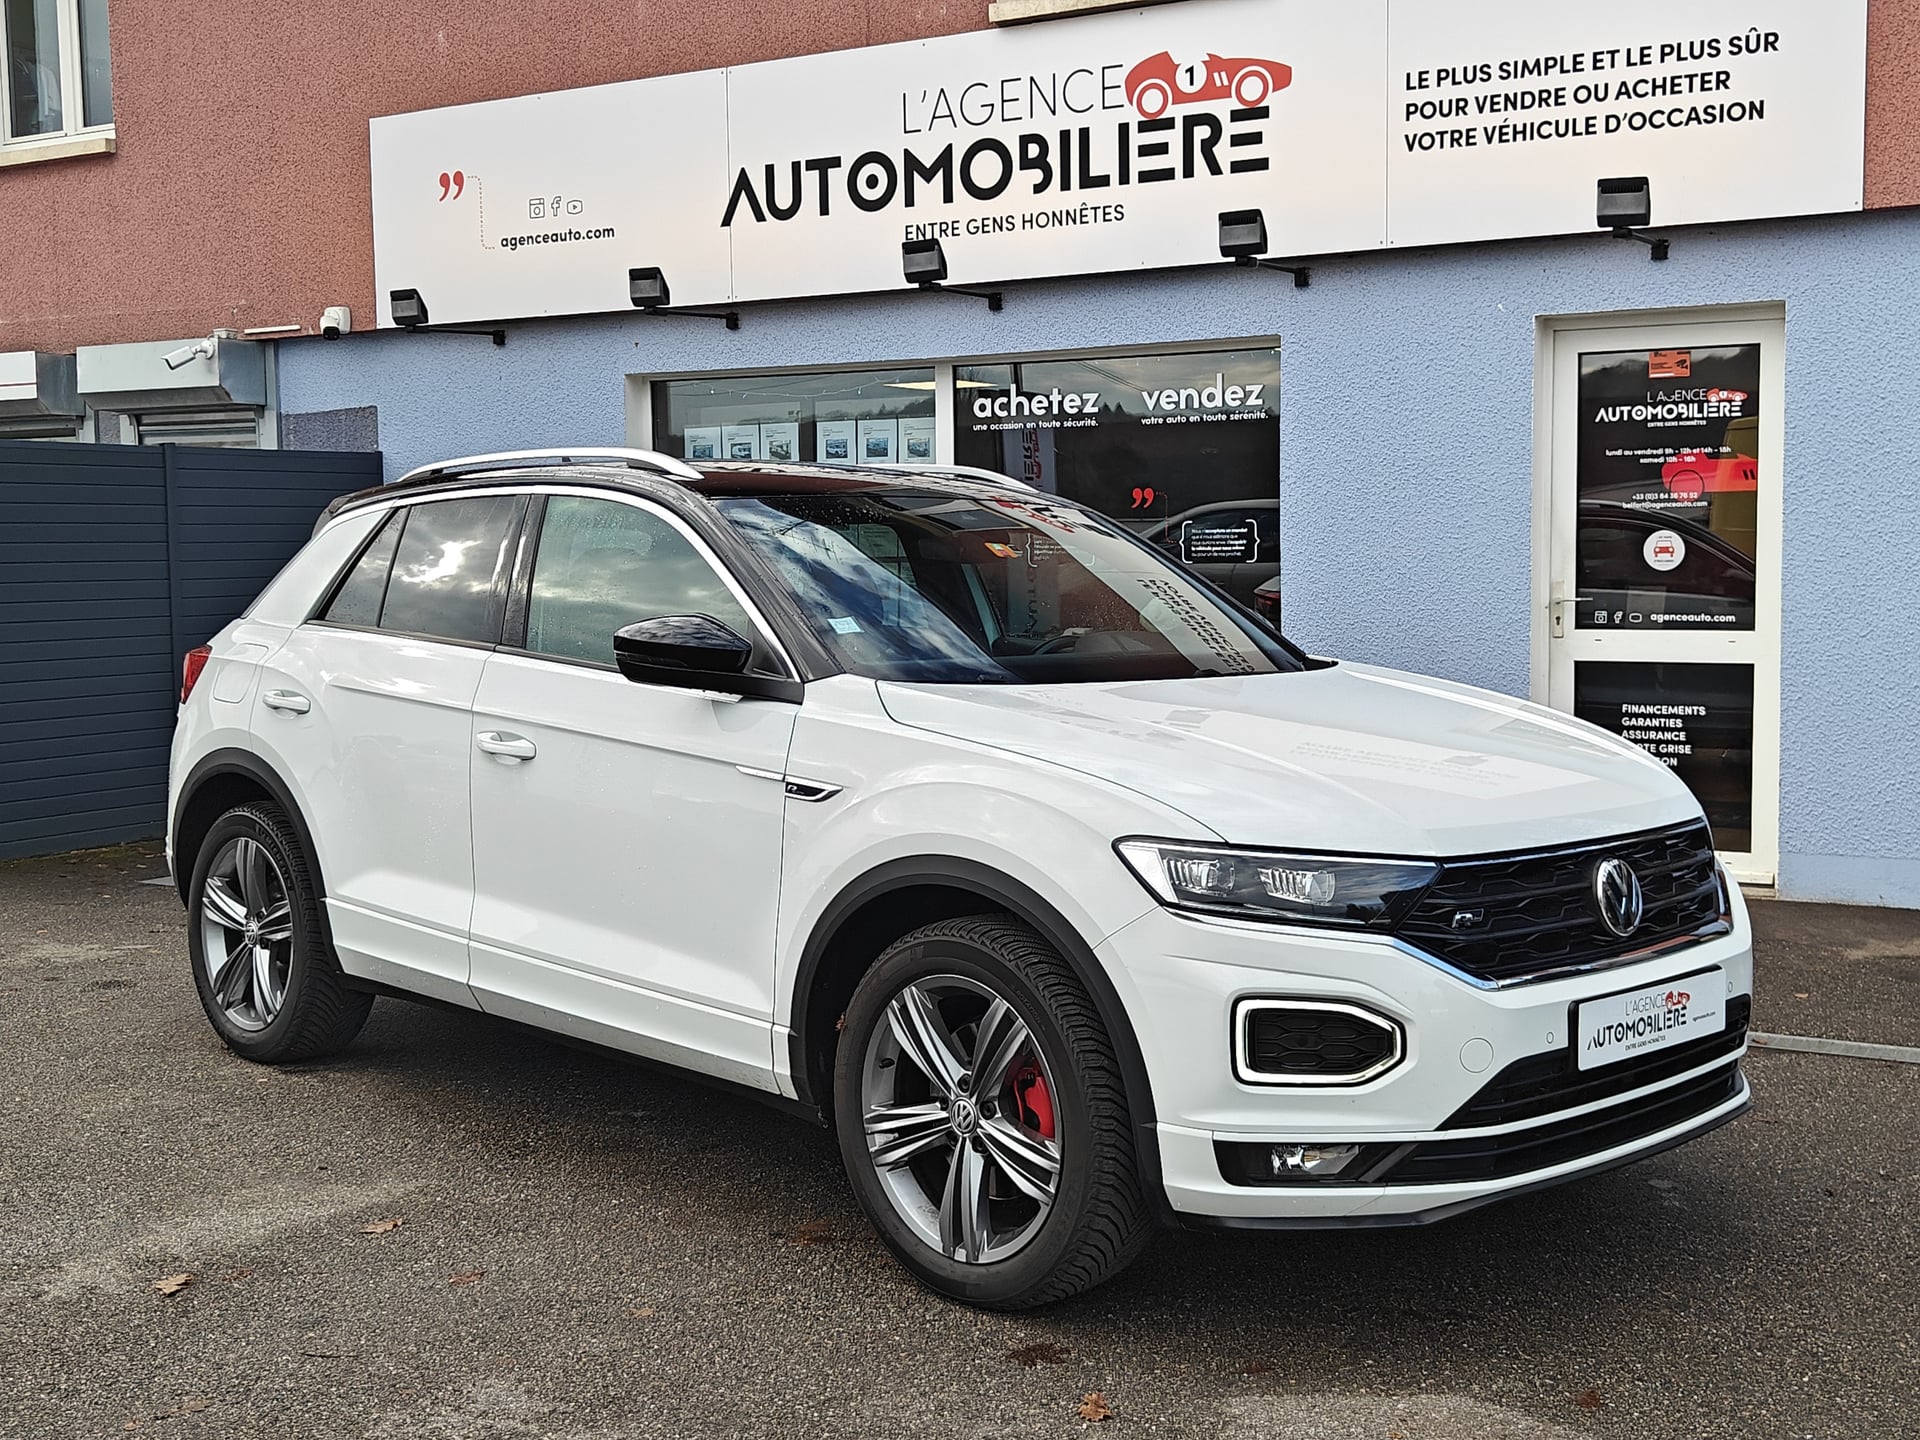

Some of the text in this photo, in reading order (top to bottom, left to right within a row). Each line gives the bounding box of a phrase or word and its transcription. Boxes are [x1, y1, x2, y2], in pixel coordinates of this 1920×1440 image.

[1406, 27, 1780, 91] LE PLUS SIMPLE ET LE PLUS SÛR
[903, 64, 1125, 134] L'AGENCE
[1405, 70, 1731, 122] POUR VENDRE OU ACHETER
[1404, 99, 1765, 152] VOTRE VÉHICULE D'OCCASION
[905, 202, 1125, 241] ENTRE GENS HONNÊTES
[500, 226, 615, 251] agenceauto.com
[973, 384, 1099, 418] achetez
[1142, 373, 1264, 411] vendez
[1647, 388, 1707, 402] LAGENCE
[990, 421, 1024, 431] occasion
[1026, 422, 1037, 430] en
[1038, 419, 1061, 429] toute
[1063, 417, 1099, 428] sécurité.
[1141, 409, 1269, 425] votre auto en toute sérénité.
[1634, 447, 1664, 455] vendredi
[1650, 613, 1736, 623] agenceauto.com
[1621, 703, 1706, 716] FINANCEMENTS
[1621, 717, 1683, 728] GARANTIES
[1621, 730, 1687, 741] ASSURANCE
[1659, 744, 1692, 754] GRISE
[1625, 992, 1666, 1016] L'AGENCE
